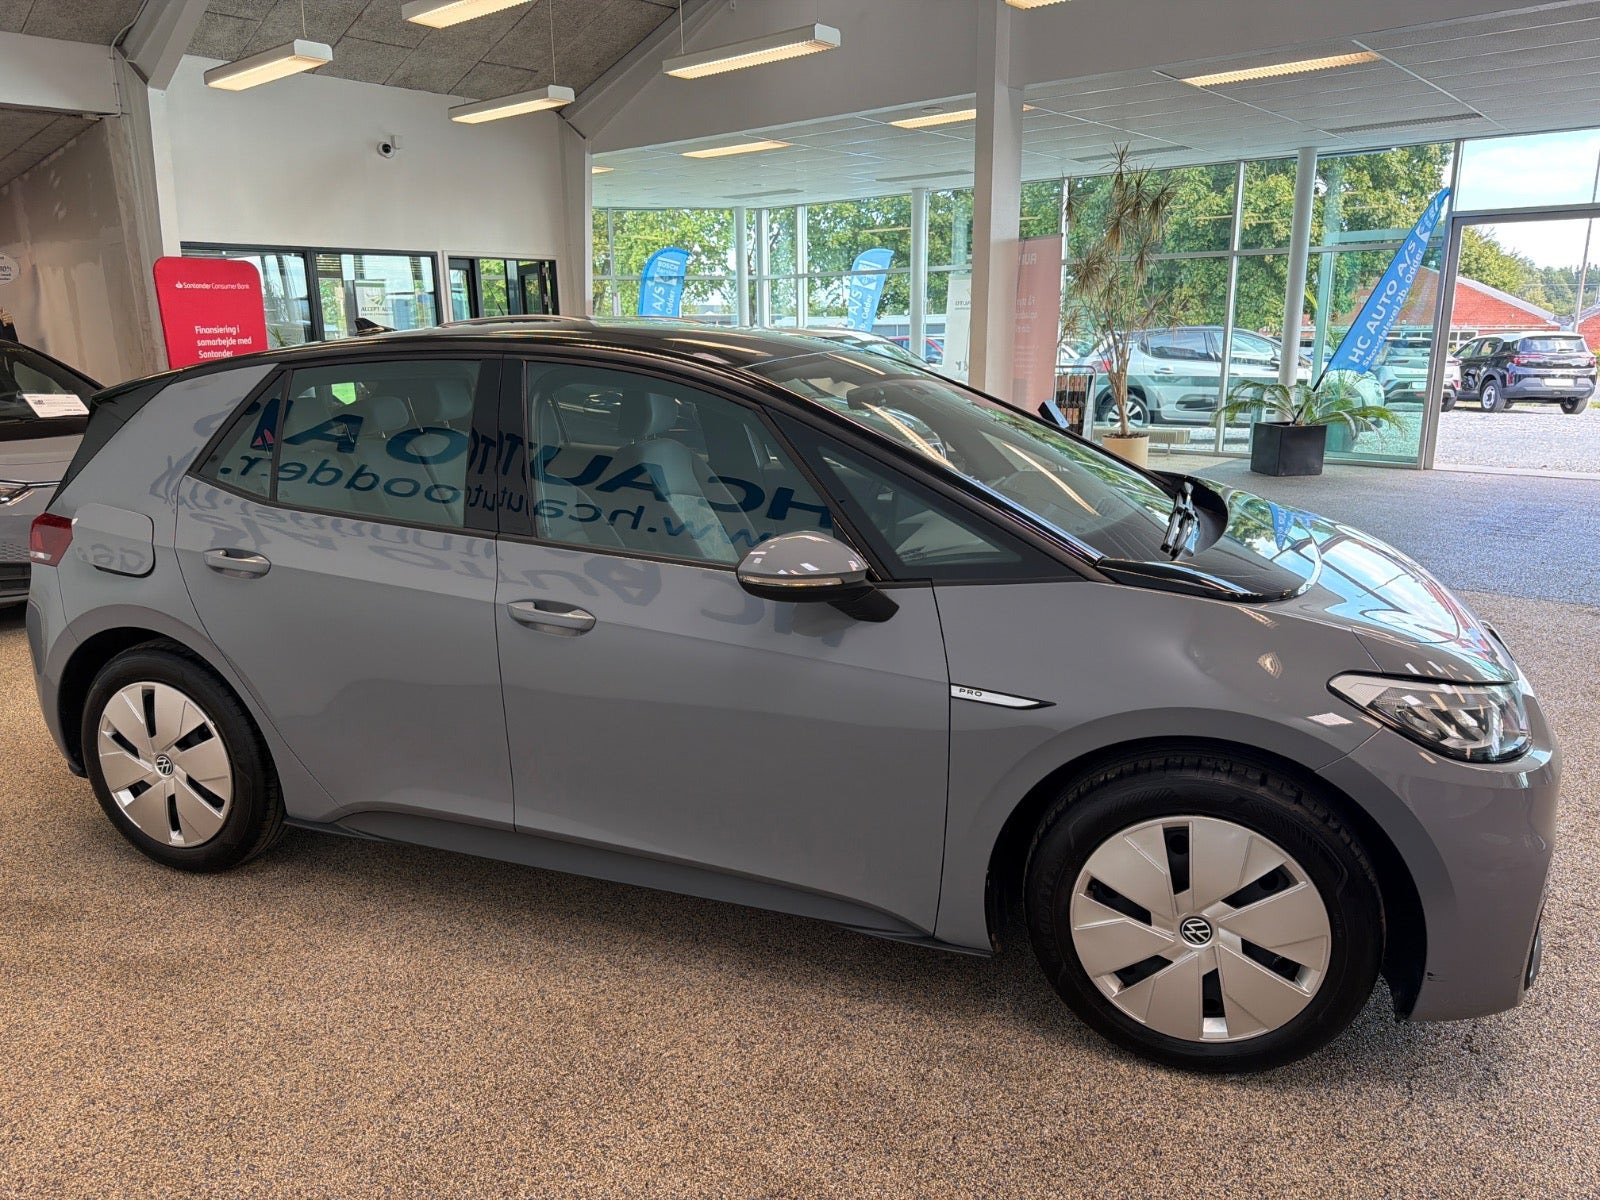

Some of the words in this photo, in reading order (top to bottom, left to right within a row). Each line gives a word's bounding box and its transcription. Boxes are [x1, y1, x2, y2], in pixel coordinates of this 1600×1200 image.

[652, 286, 666, 312] A/S
[666, 290, 675, 315] Odder
[848, 289, 863, 316] A/S
[861, 294, 873, 319] Odder
[1348, 336, 1371, 364] HC
[1366, 280, 1398, 335] AUTO
[1397, 240, 1416, 277] A/S
[1362, 305, 1400, 367] Skovdalsvej
[1405, 248, 1424, 283] Odder
[195, 325, 236, 335] Finansiering
[197, 337, 236, 347] samarbejde
[237, 336, 252, 344] med
[198, 350, 233, 358] Santander
[959, 688, 983, 697] PRO
